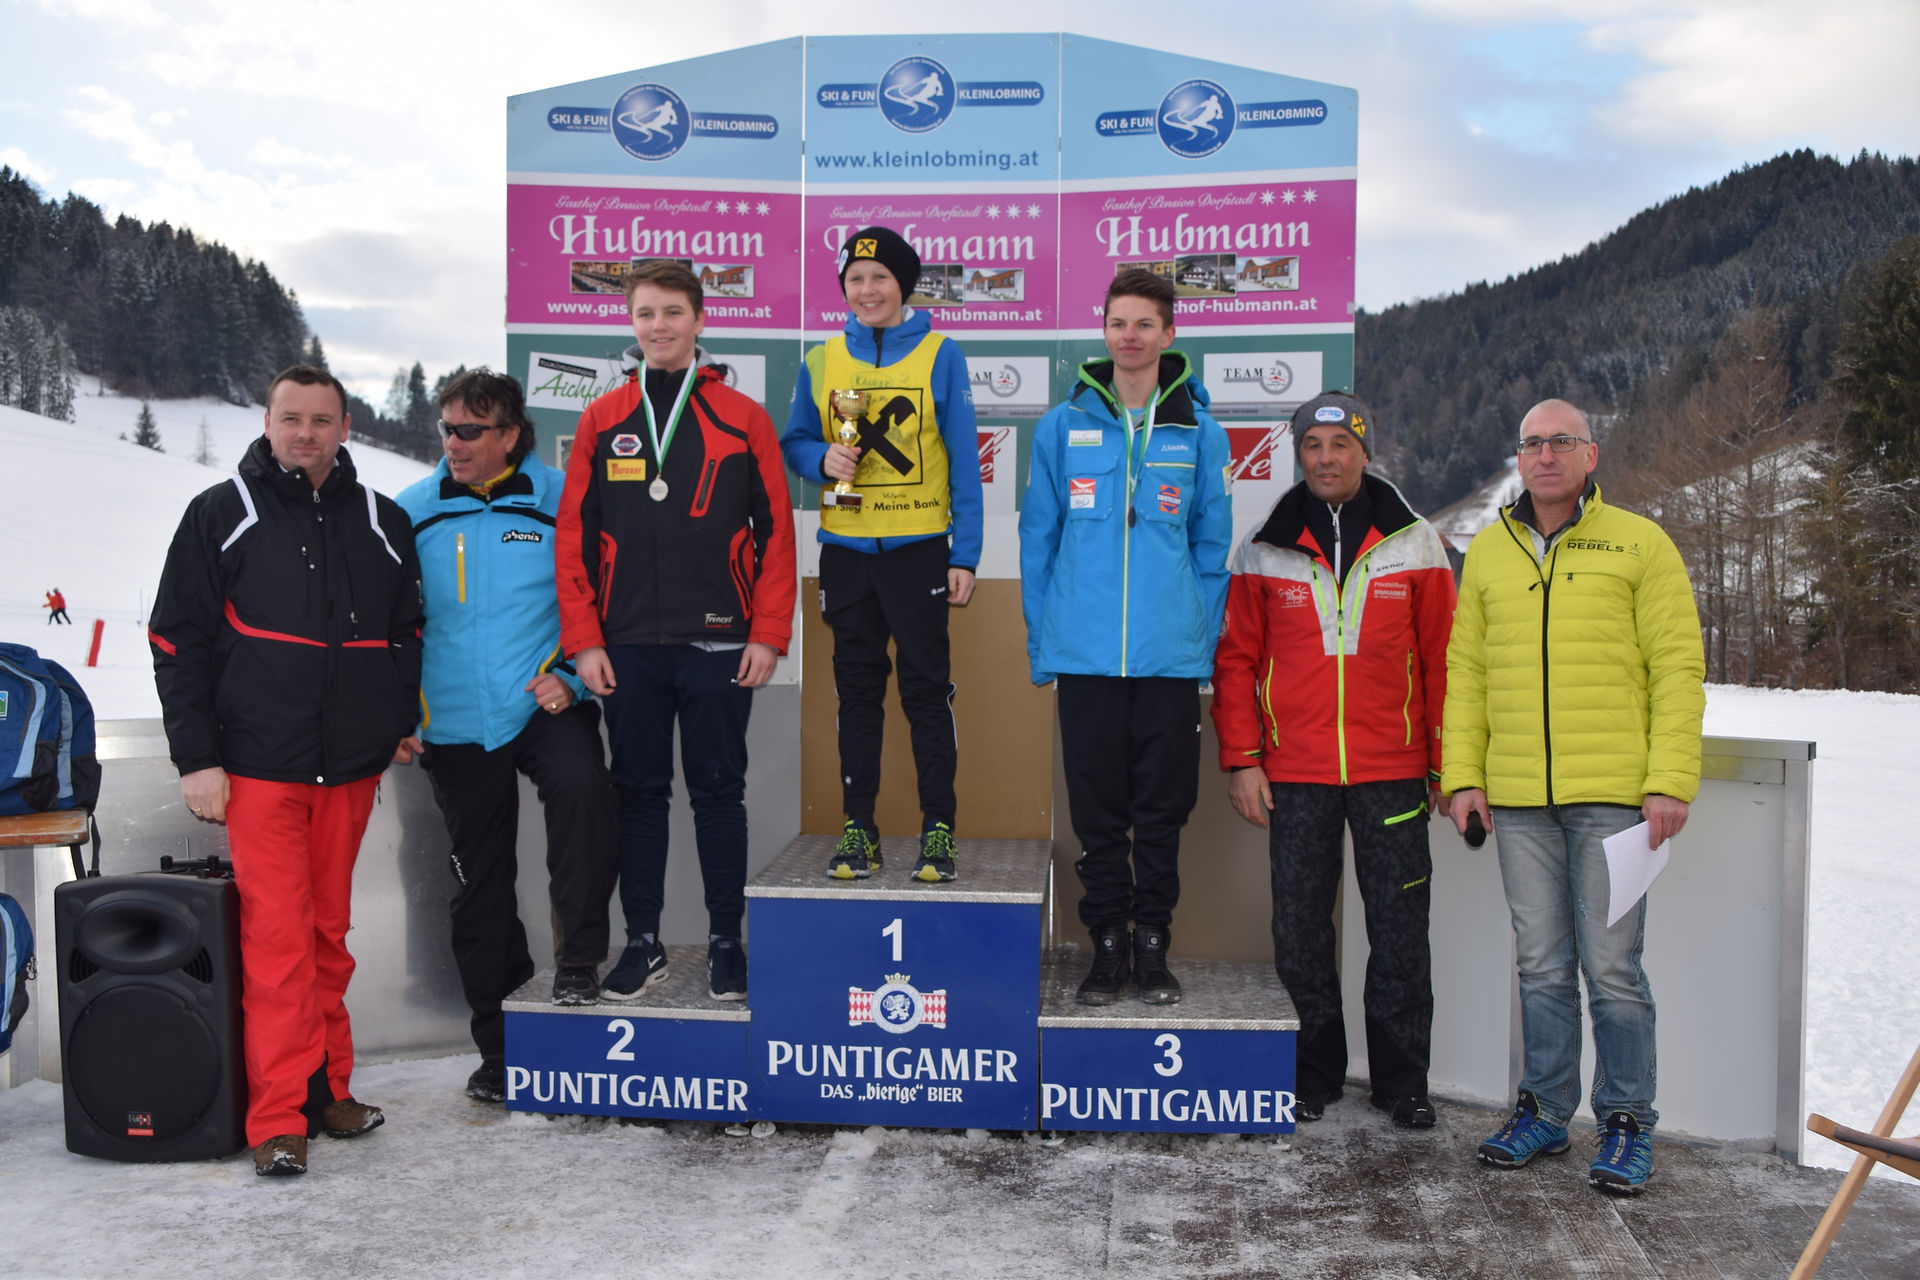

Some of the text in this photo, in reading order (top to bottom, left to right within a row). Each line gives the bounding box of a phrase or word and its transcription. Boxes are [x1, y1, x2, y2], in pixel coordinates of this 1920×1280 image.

[821, 90, 875, 102] SKI & FUN
[959, 88, 1040, 100] KLEINLOBMING
[552, 113, 608, 126] SKI & FUN
[1239, 106, 1324, 121] KLEINLOBMING
[694, 119, 775, 132] KLEINLOBMING
[1100, 116, 1154, 130] SKI & FUN
[815, 150, 1039, 170] www.kleinlobming.at
[555, 195, 603, 212] Gasthof
[603, 196, 652, 211] Pension
[1102, 196, 1148, 213] Gasthof
[1148, 194, 1196, 210] Pension
[830, 204, 876, 222] Gasthof
[877, 205, 923, 220] Pension
[549, 214, 765, 258] Hubmann
[1095, 213, 1312, 257] Hubmann
[1223, 367, 1264, 378] TEAM
[531, 372, 628, 409] Aichfel
[873, 501, 911, 511] Meine
[913, 498, 941, 509] Bank
[503, 530, 541, 541] phenix
[1567, 542, 1625, 553] REBELS
[882, 918, 903, 961] 1
[606, 1019, 635, 1061] 2
[768, 1040, 1018, 1082] PUNTIGAMER
[1153, 1033, 1183, 1077] 3
[506, 1066, 749, 1111] PUNTIGAMER
[820, 1083, 854, 1099] DAS
[927, 1086, 963, 1102] BIER
[1041, 1083, 1296, 1123] PUNTIGAMER
